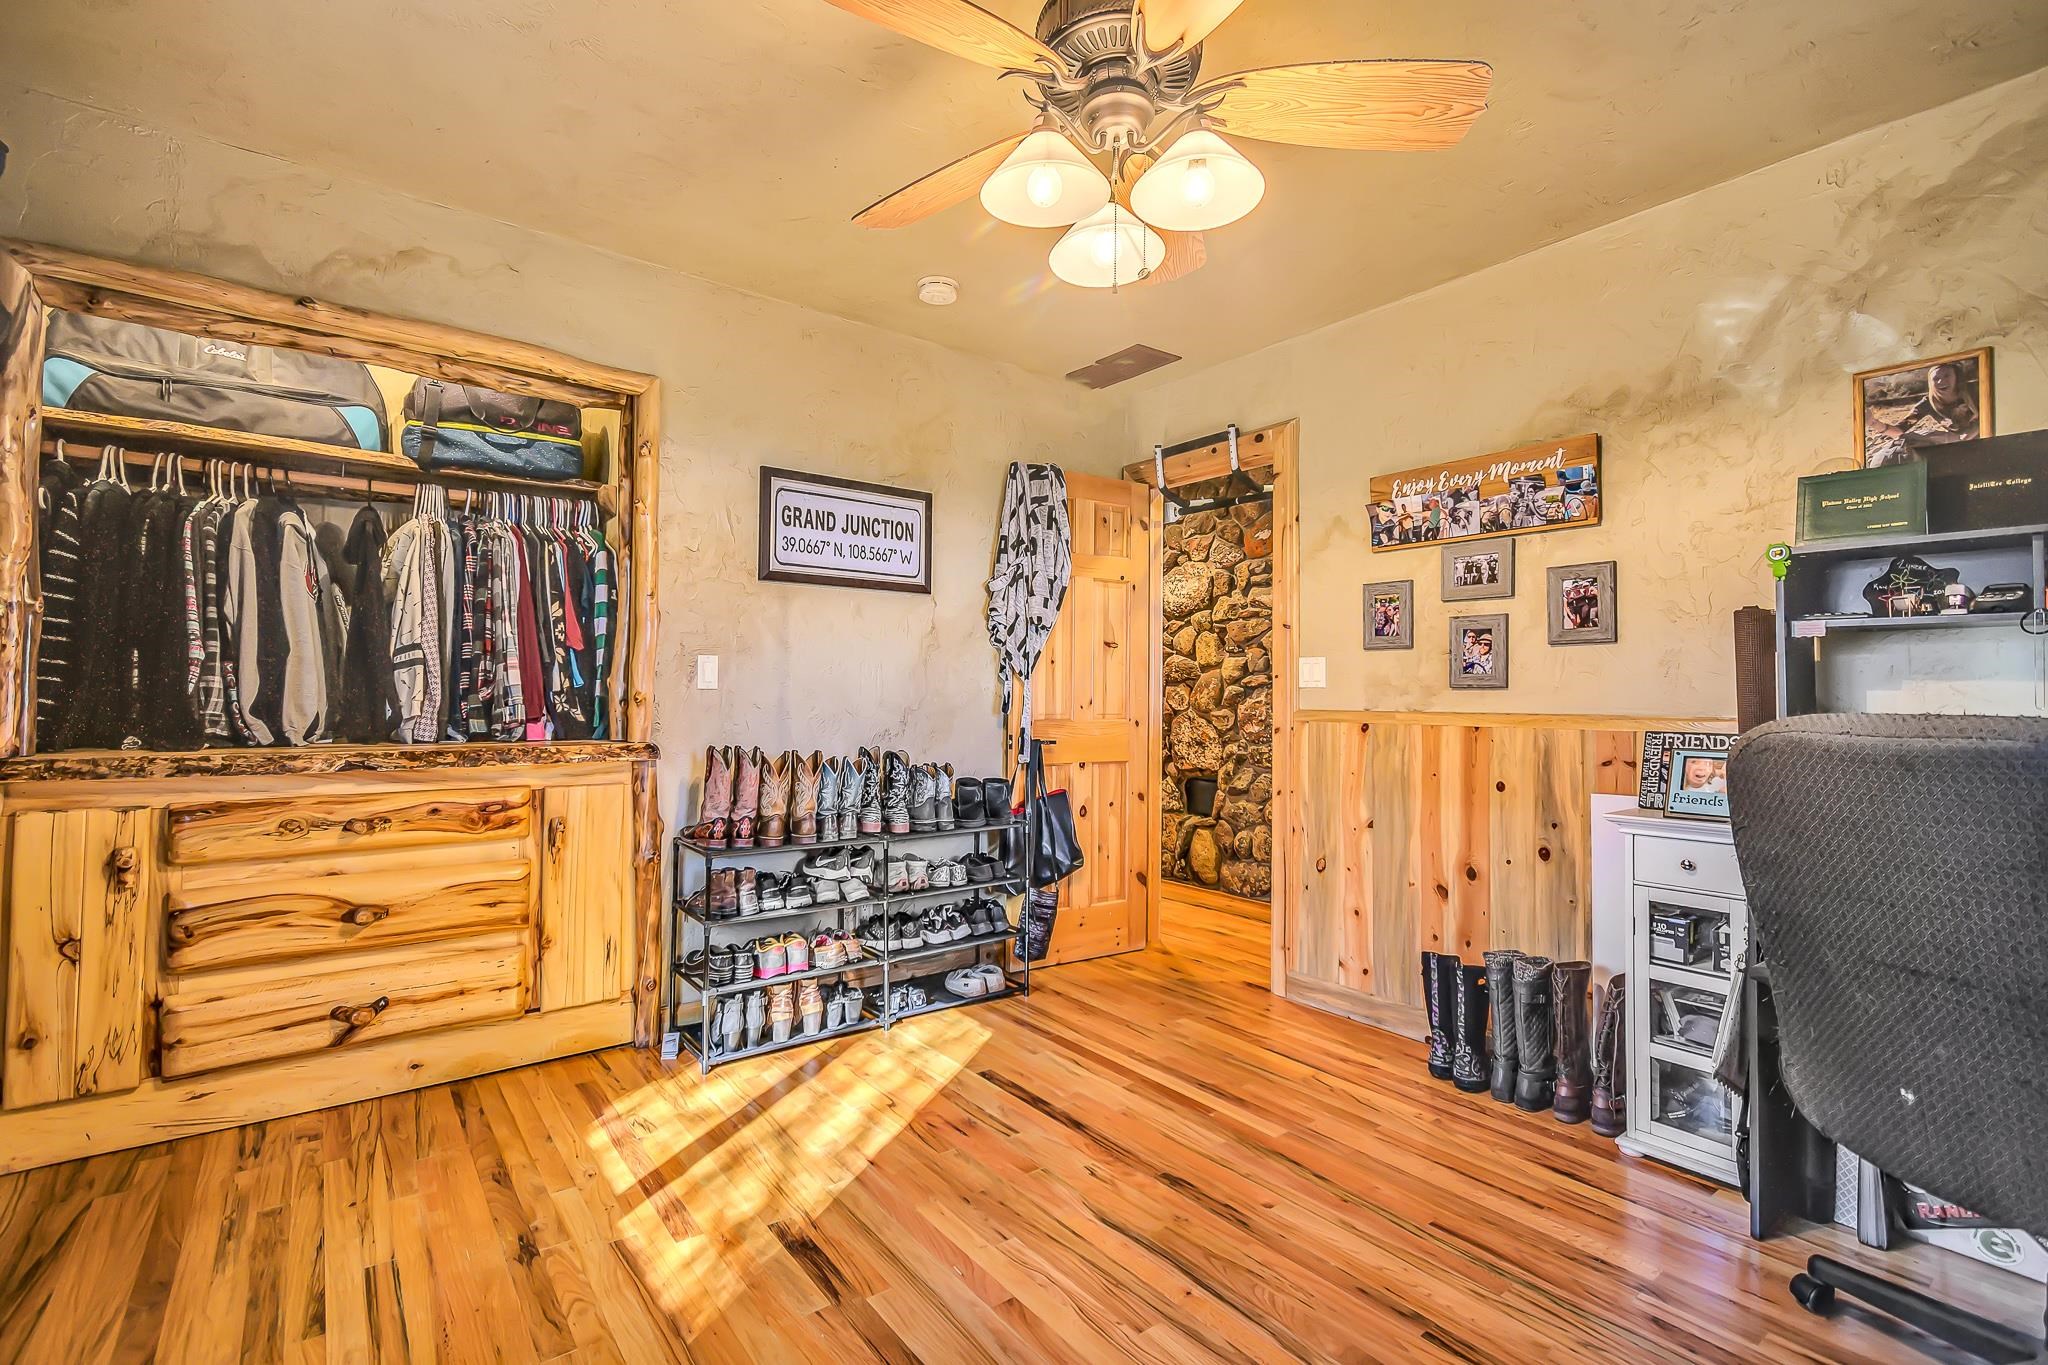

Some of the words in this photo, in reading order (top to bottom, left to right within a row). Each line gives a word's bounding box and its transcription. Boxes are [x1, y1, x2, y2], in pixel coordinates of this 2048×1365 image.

[499, 415, 573, 437] DINE
[1391, 476, 1438, 500] Enjoy
[1438, 469, 1488, 492] Every
[1487, 447, 1567, 483] Moment
[1862, 495, 1878, 503] High
[781, 505, 836, 532] GRAND
[841, 513, 914, 543] JUNCTION
[781, 536, 831, 556] 39.0667°
[833, 542, 846, 559] N,
[848, 543, 898, 563] 108.5667°
[900, 551, 913, 565] W
[1647, 732, 1664, 793] FRIENDSHIP
[1671, 792, 1724, 807] friends
